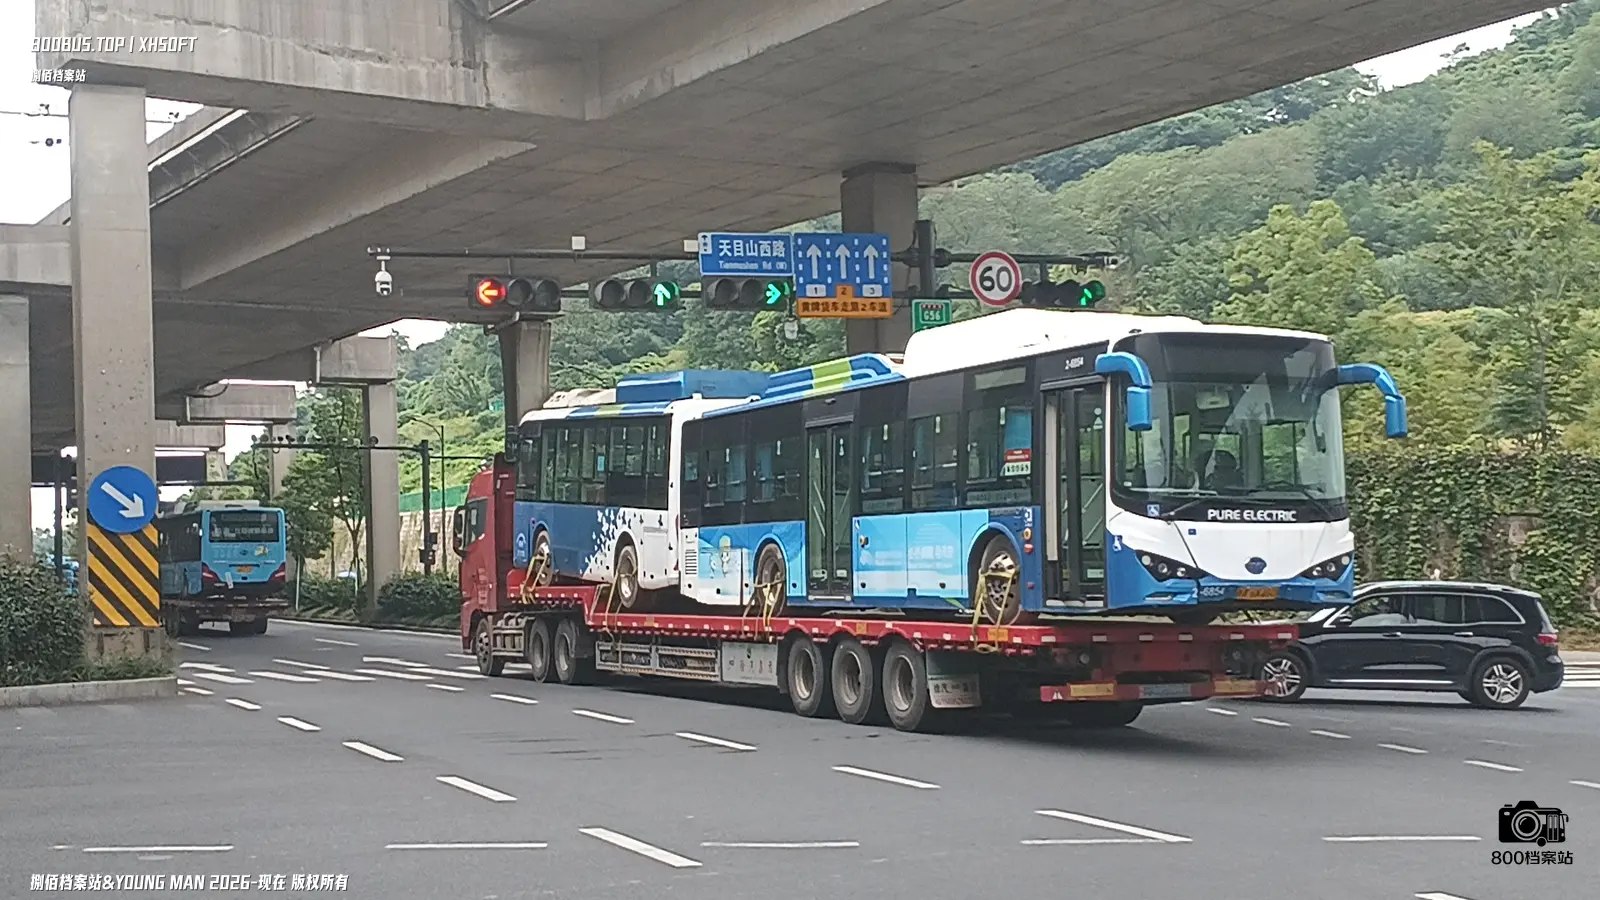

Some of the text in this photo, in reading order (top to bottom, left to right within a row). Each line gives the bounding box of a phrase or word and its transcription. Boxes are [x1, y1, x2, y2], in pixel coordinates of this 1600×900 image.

[718, 240, 786, 258] 天目山西路
[979, 266, 1012, 292] 60
[840, 286, 848, 296] 2
[868, 287, 876, 295] 3
[923, 310, 941, 321] G56
[1207, 509, 1297, 522] PURE ELECTRIC
